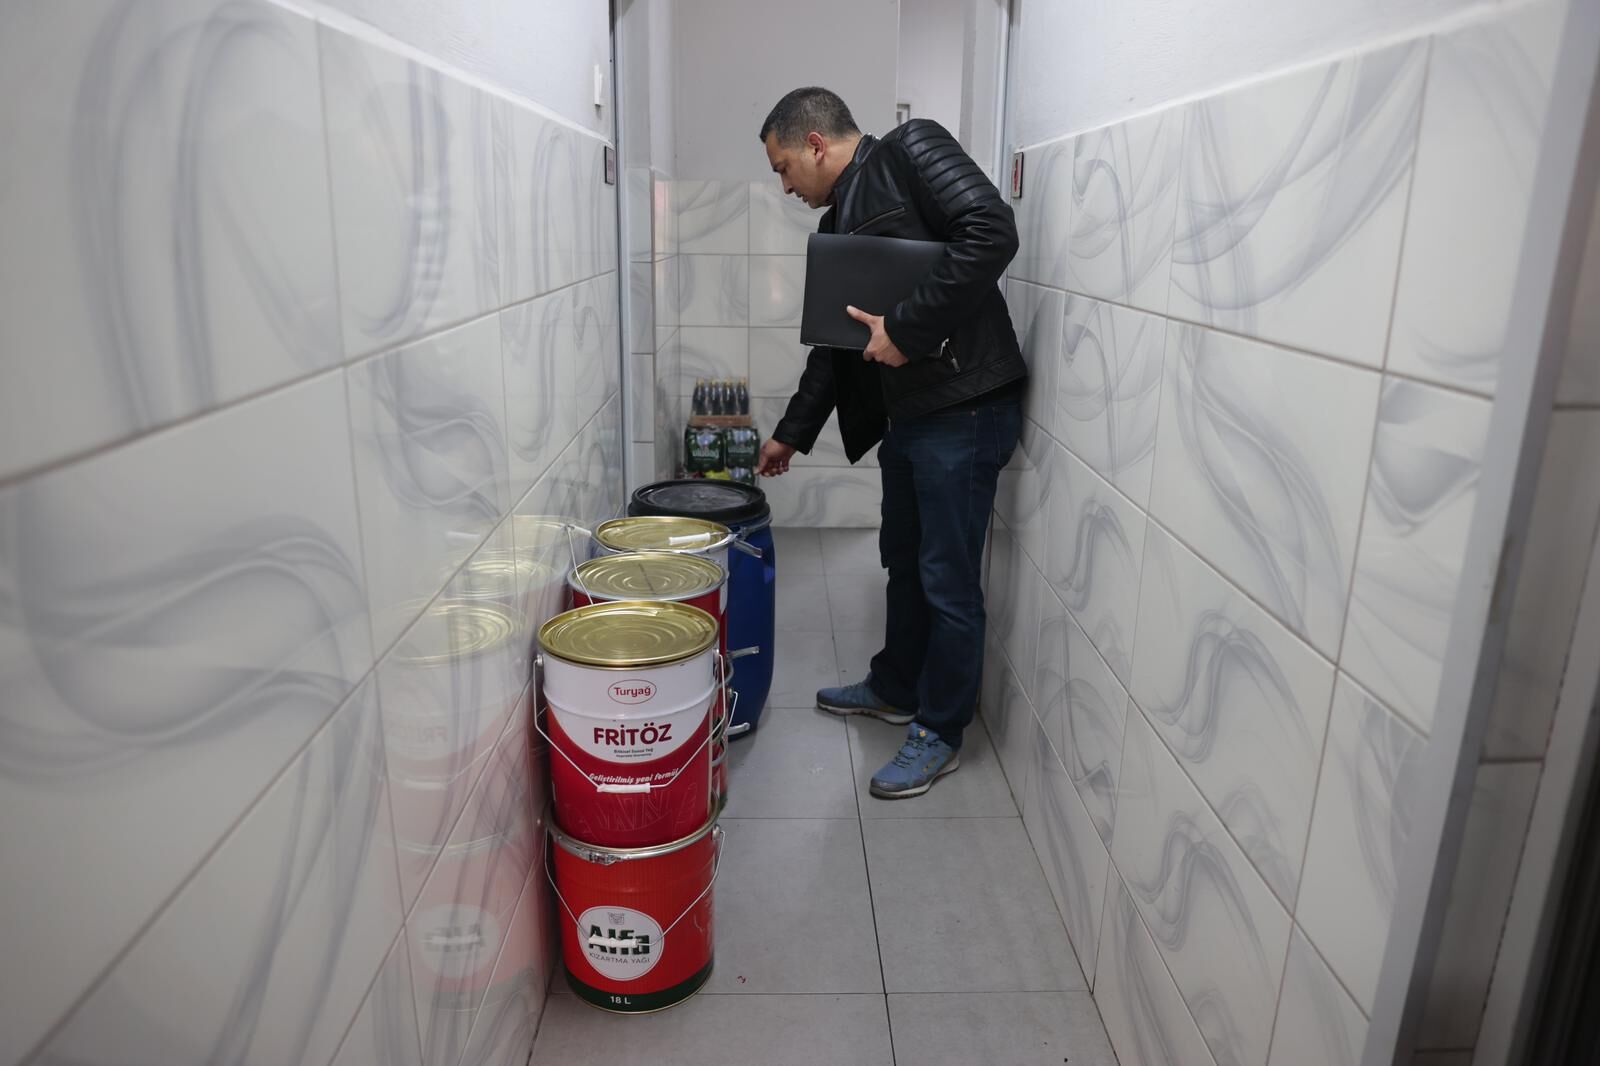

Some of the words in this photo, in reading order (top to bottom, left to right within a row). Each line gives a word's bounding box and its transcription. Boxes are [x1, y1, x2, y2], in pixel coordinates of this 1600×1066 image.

[614, 685, 651, 697] Turyağ
[593, 722, 672, 746] FRİTÖZ
[589, 773, 633, 784] Geliştirilmiş
[635, 774, 653, 784] yeni
[589, 952, 628, 963] KIZARTMA
[610, 995, 622, 1004] 18
[624, 996, 631, 1005] L
